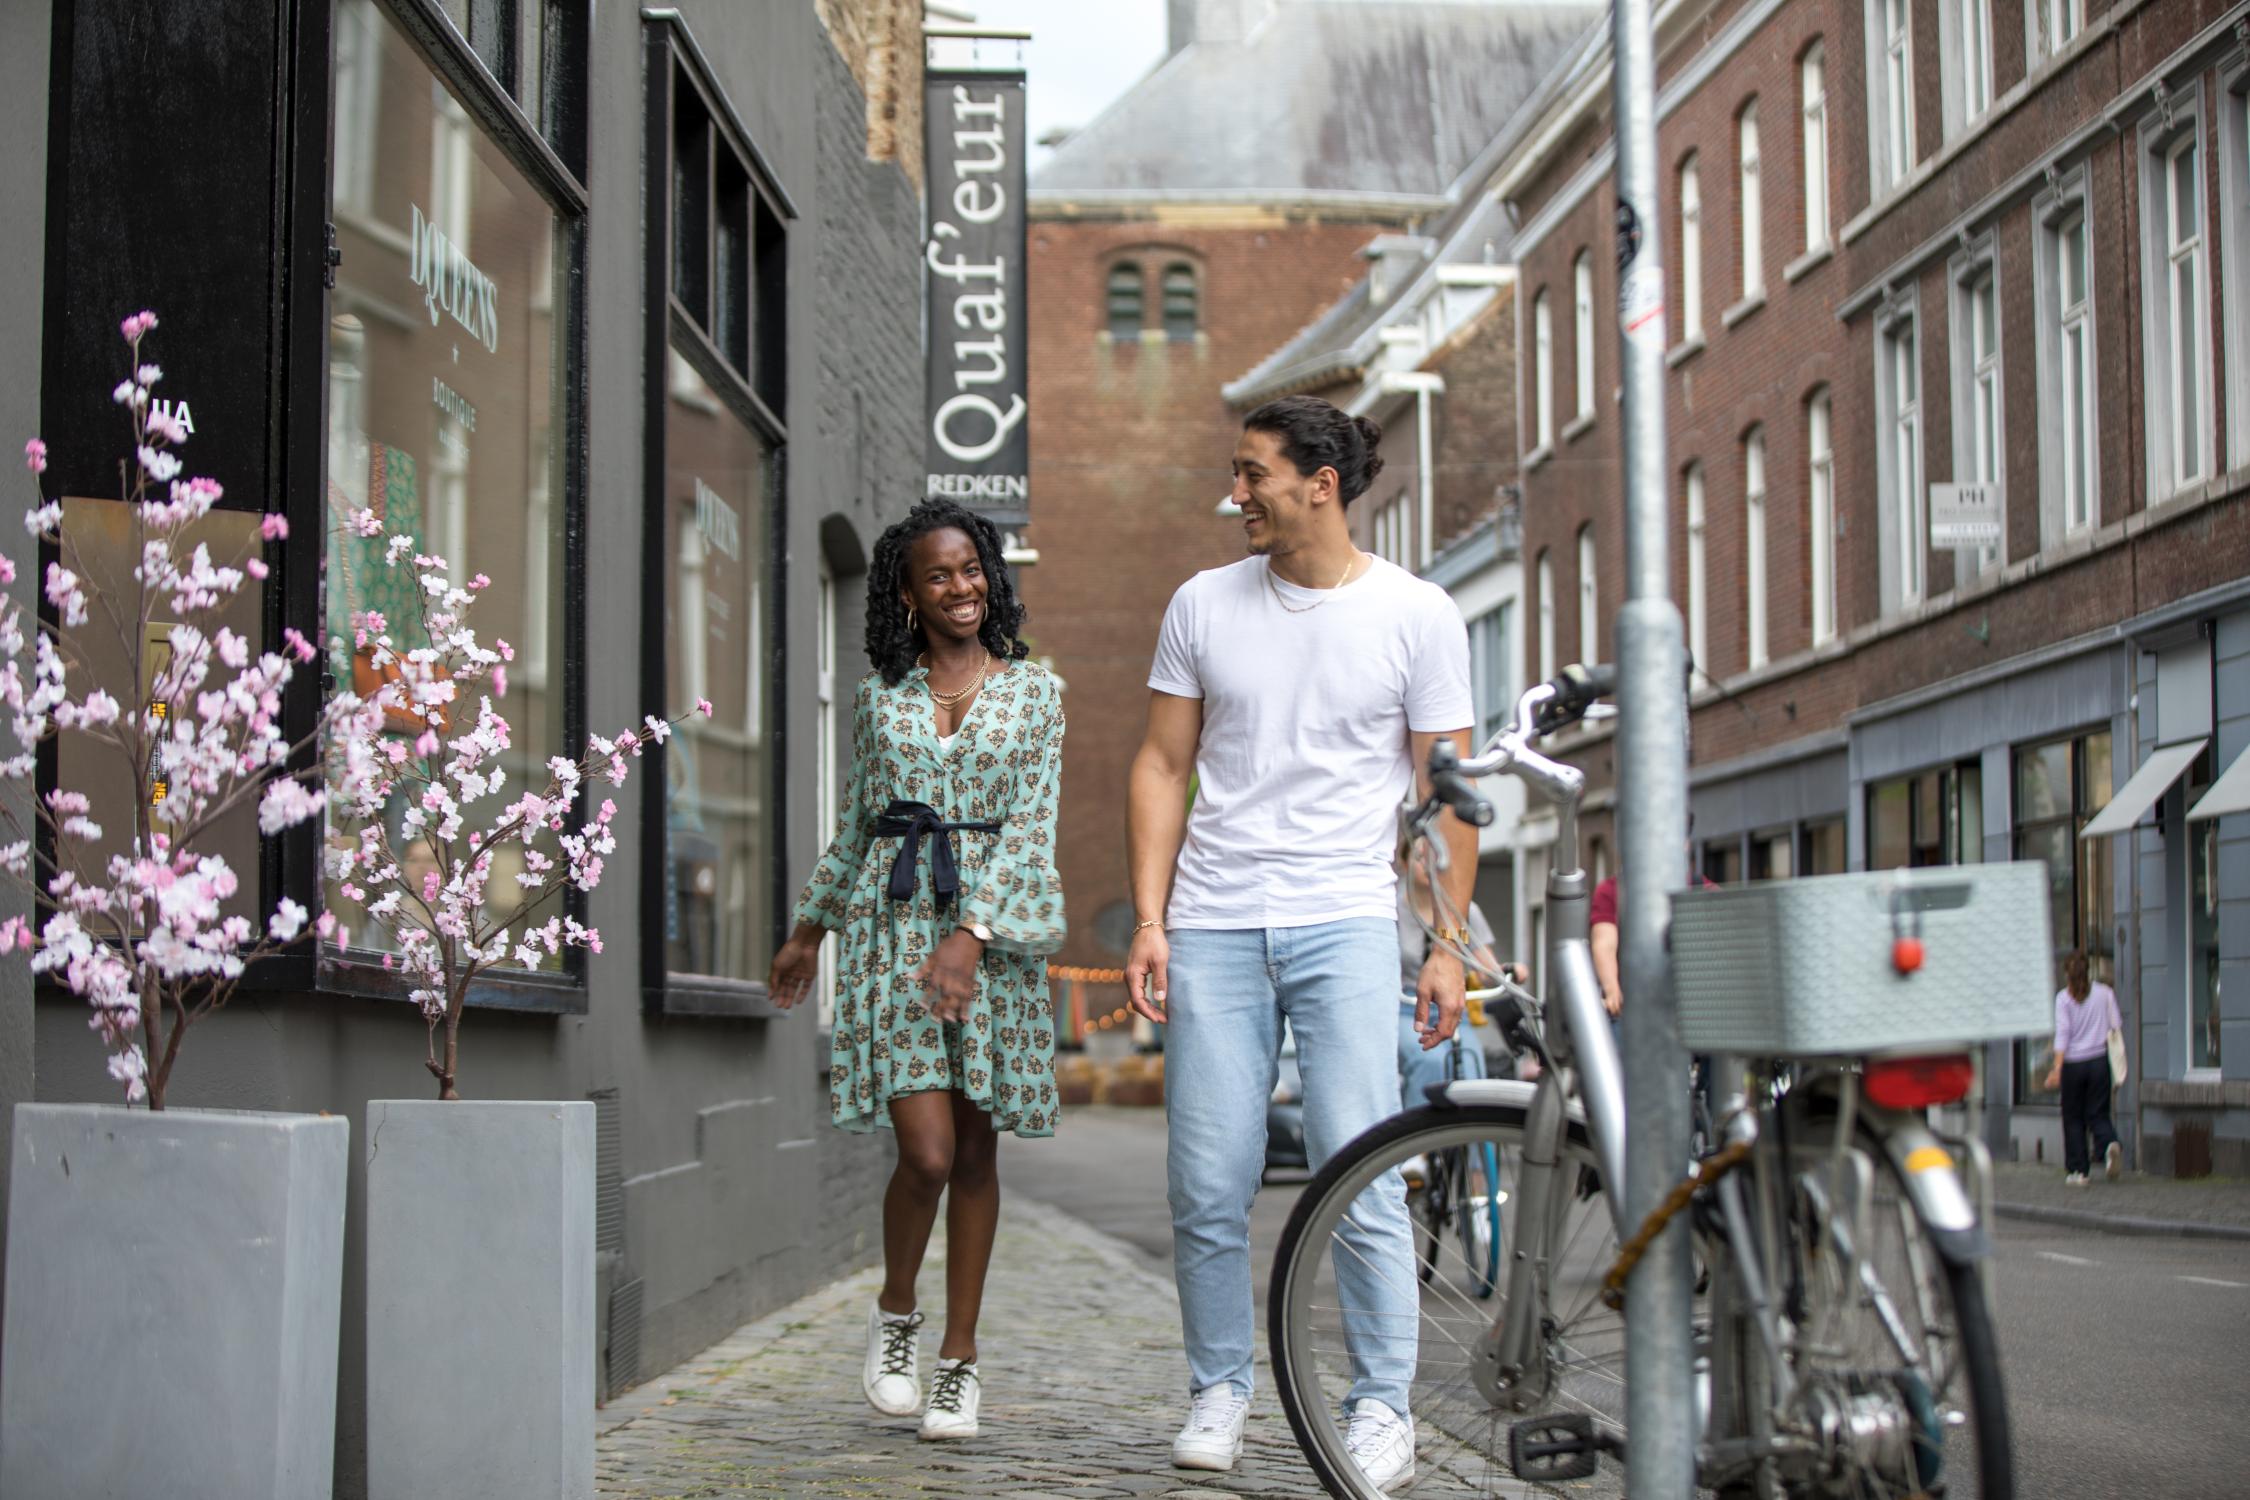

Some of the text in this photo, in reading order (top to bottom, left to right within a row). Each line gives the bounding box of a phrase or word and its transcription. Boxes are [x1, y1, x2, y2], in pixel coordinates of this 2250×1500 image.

[411, 202, 497, 354] DQUEENS
[927, 85, 1027, 462] Quaf'eur
[433, 376, 477, 432] BOUTIQUE
[926, 474, 1028, 498] REDKEN
